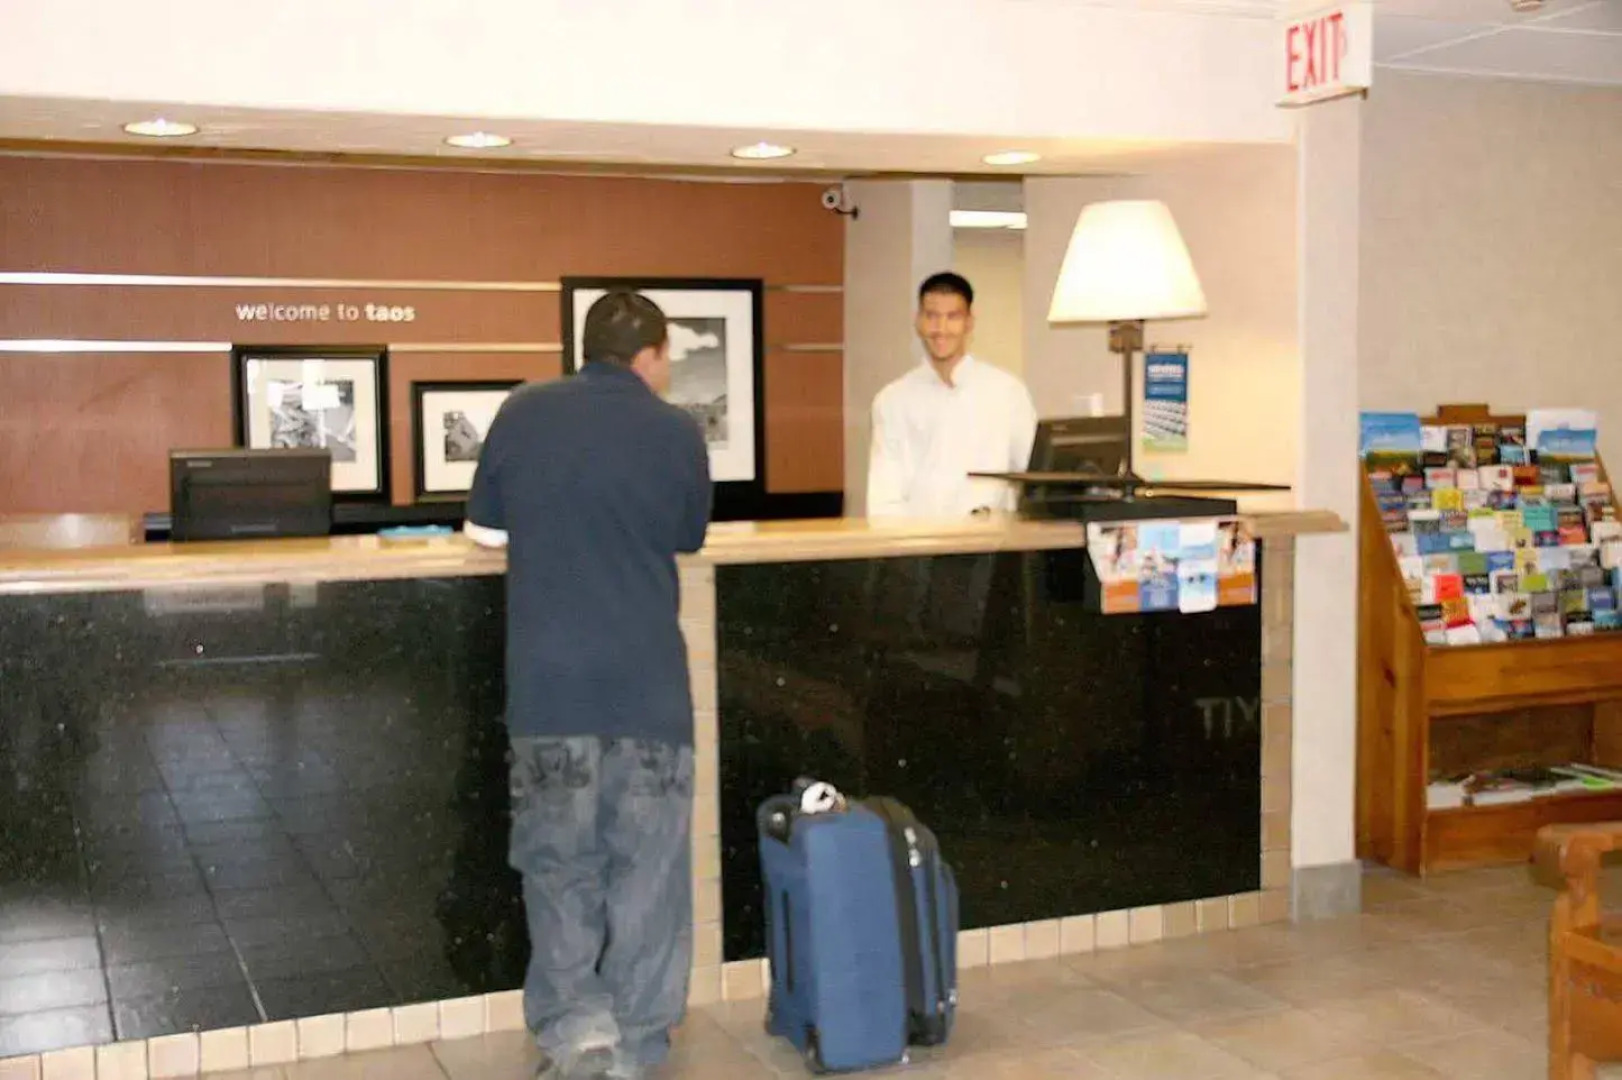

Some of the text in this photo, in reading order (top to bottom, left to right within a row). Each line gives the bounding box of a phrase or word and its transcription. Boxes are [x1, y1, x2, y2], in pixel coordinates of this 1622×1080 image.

[1286, 11, 1343, 92] EXIT
[235, 302, 416, 322] welcome to taos
